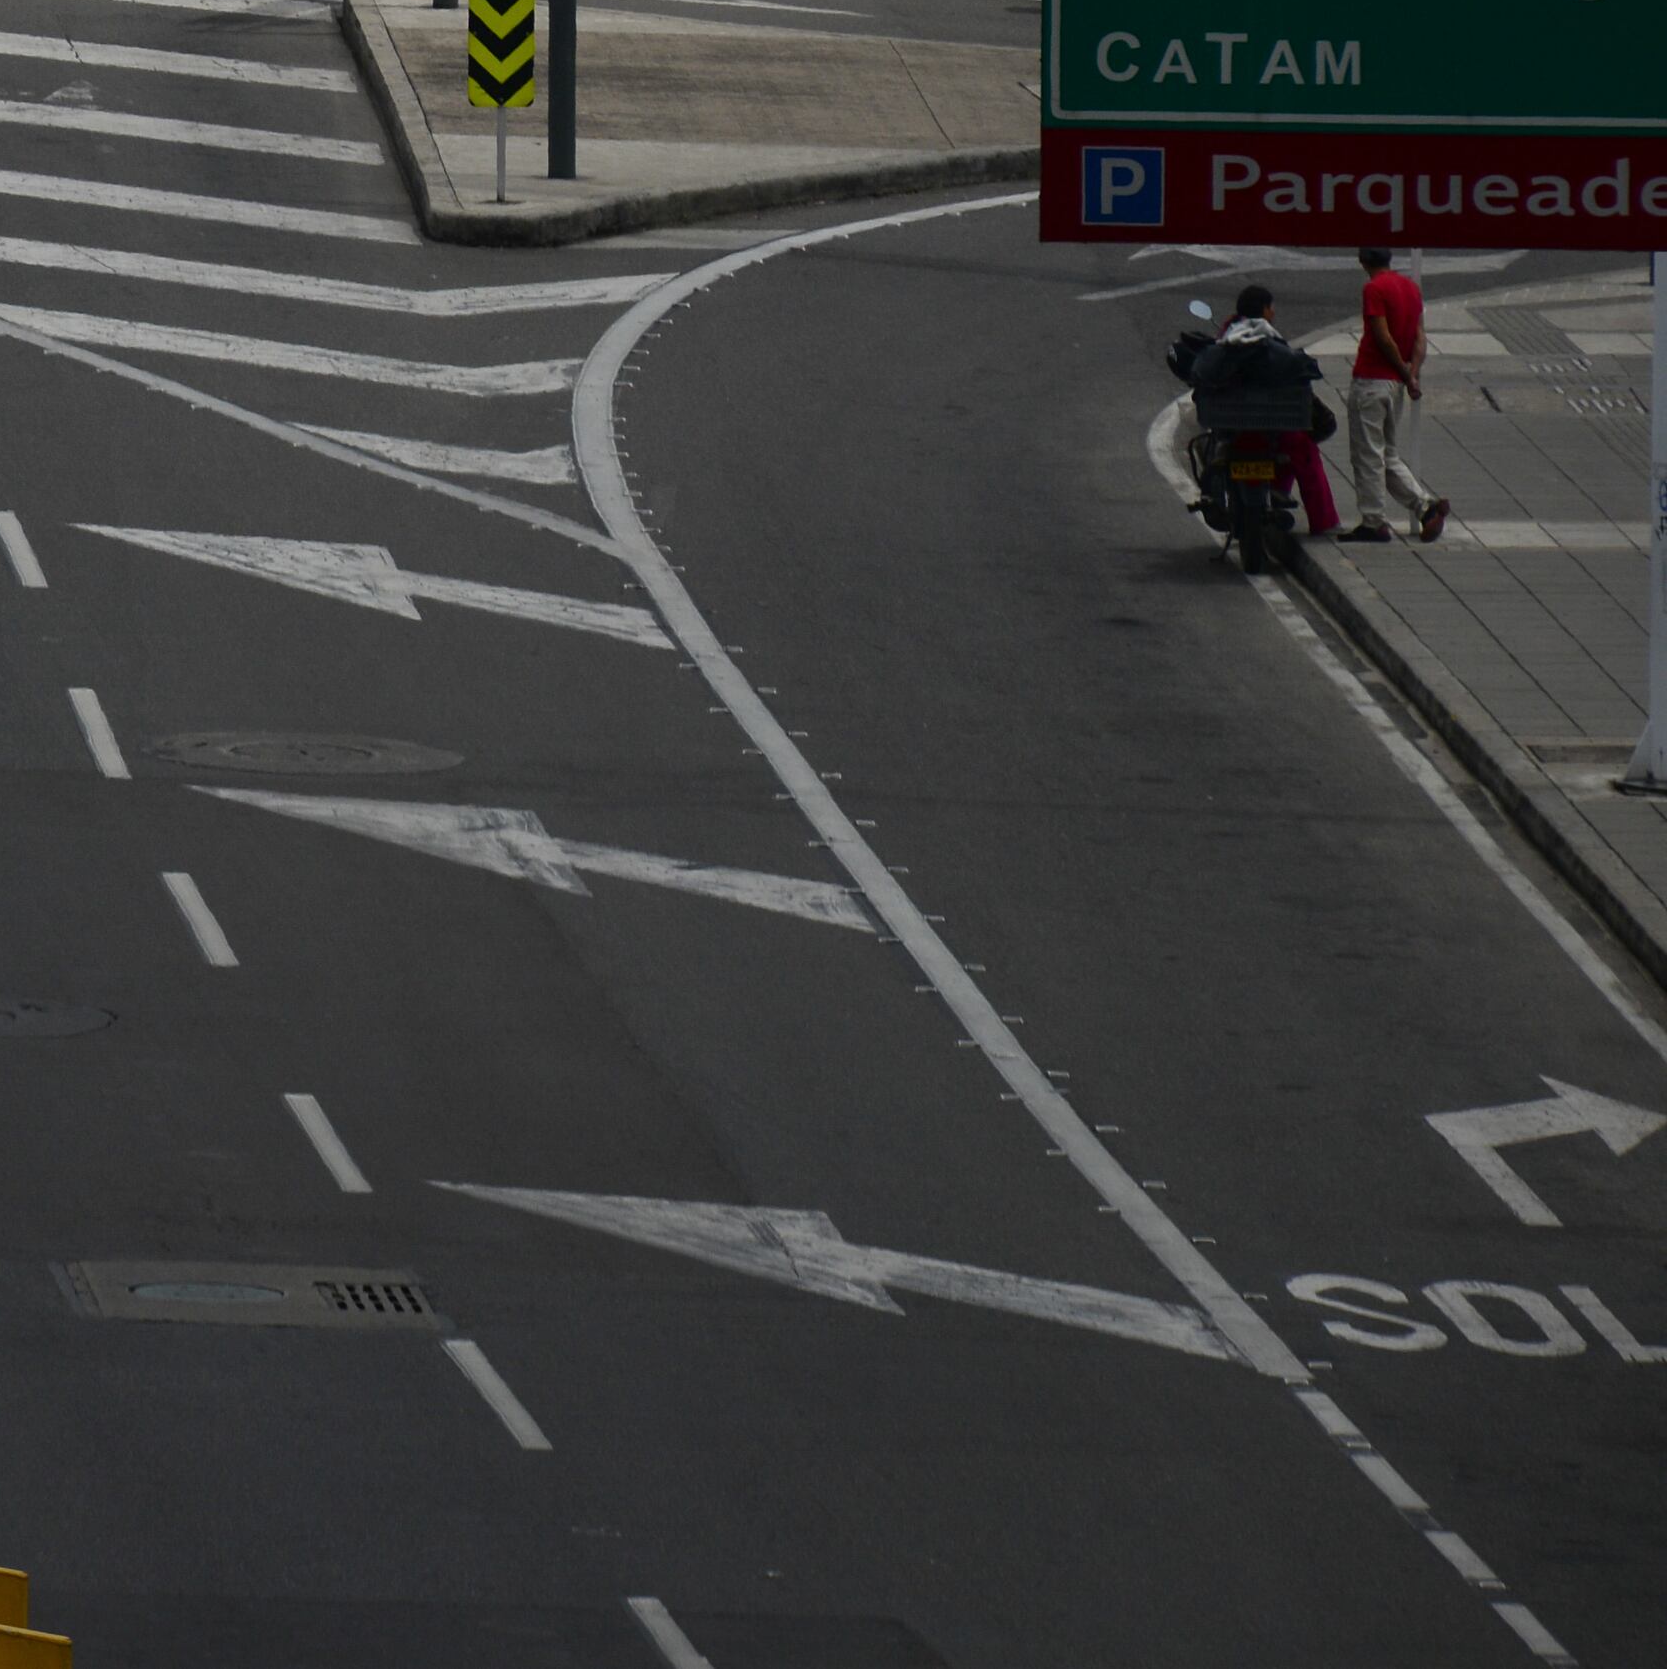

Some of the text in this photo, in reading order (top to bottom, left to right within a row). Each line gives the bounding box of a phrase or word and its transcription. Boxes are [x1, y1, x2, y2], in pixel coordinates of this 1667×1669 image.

[1097, 31, 1362, 86] CATAM
[1100, 153, 1667, 233] P Parqueade
